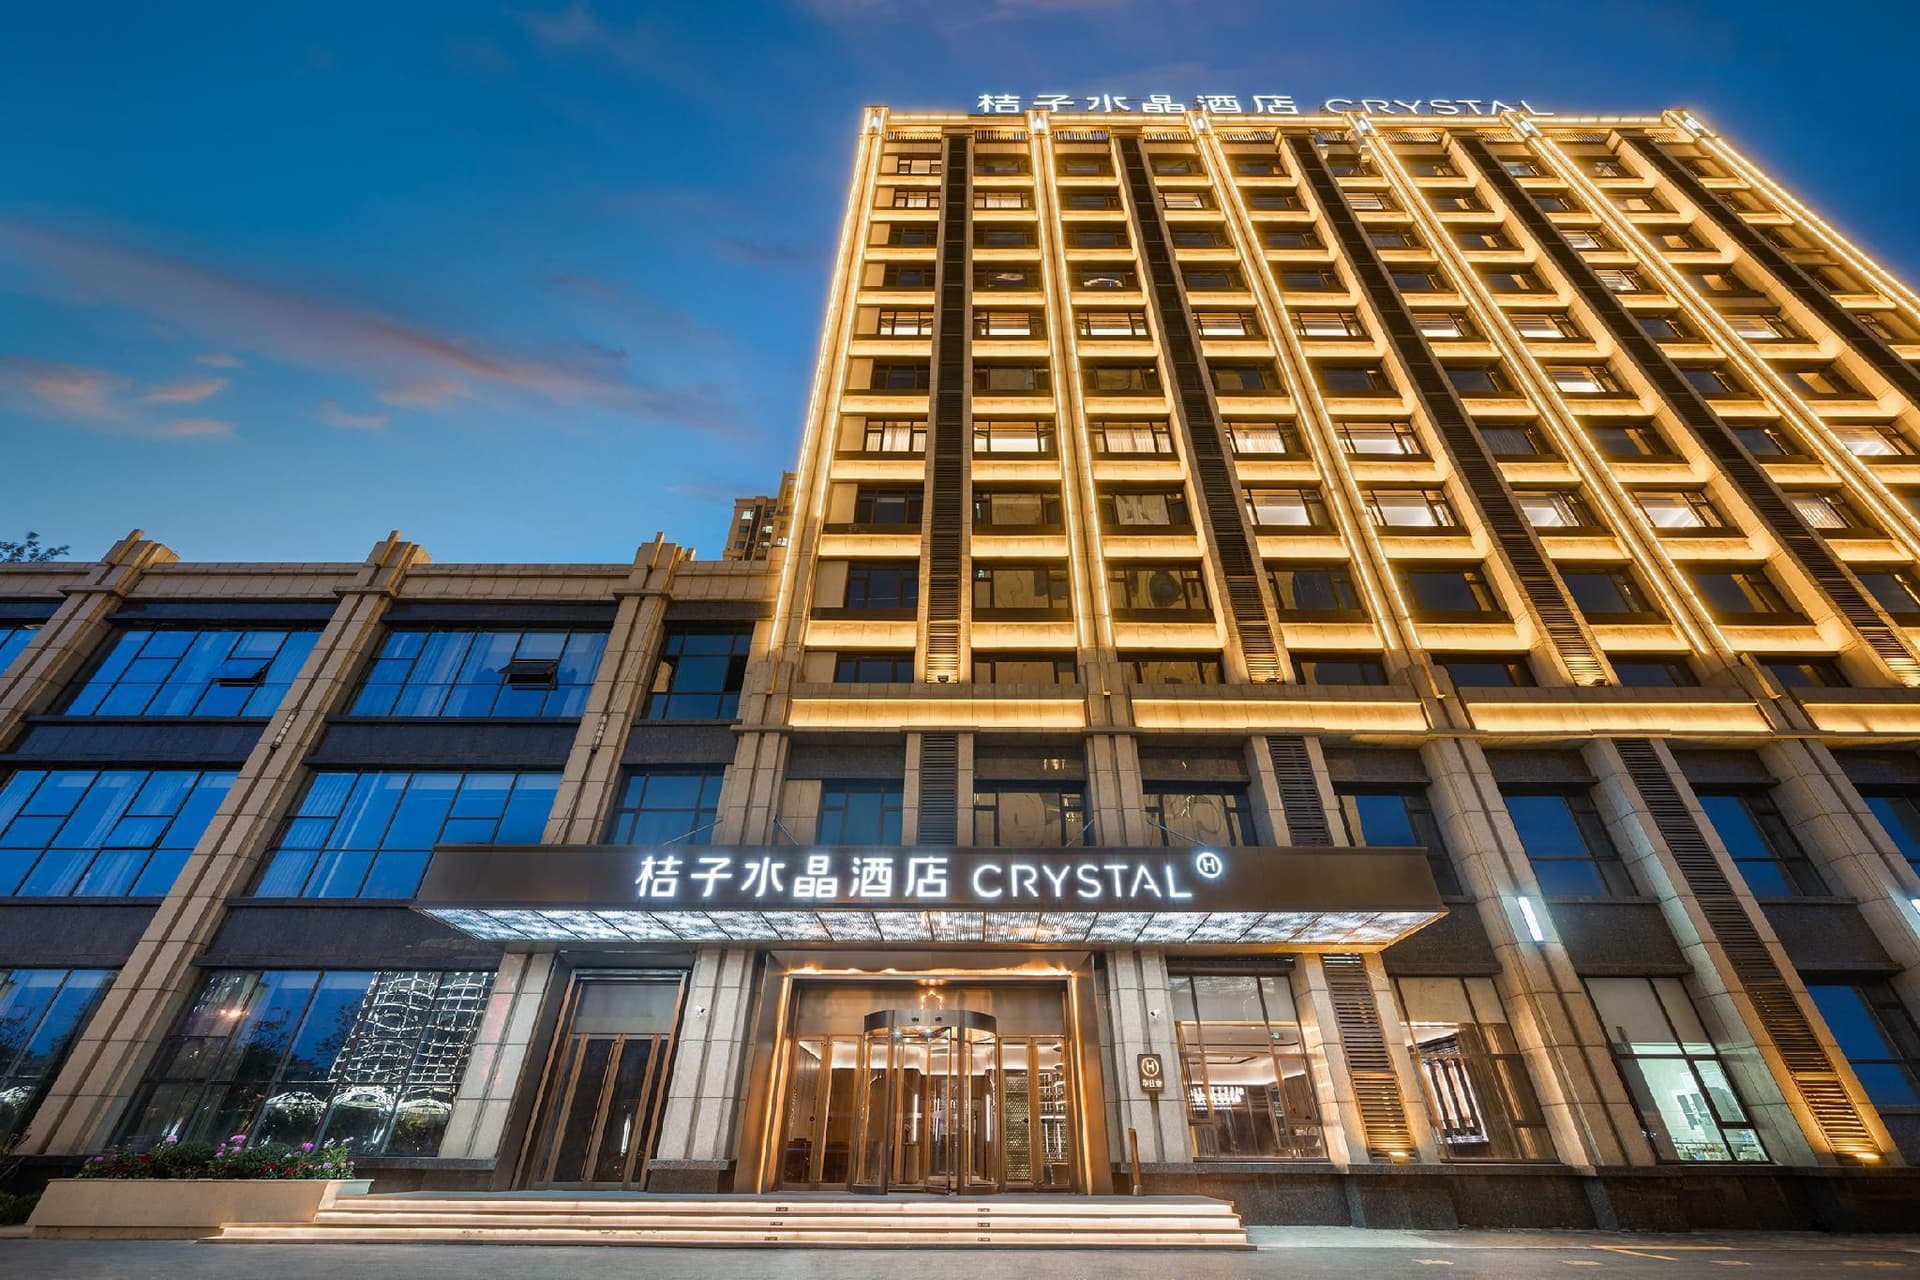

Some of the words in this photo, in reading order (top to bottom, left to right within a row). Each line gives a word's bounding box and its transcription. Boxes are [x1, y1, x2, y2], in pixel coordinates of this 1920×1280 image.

[977, 94, 1299, 114] 桔子水晶酒店
[1325, 99, 1554, 115] CRYSTAL
[635, 855, 948, 897] 桔子水晶酒店
[973, 864, 1193, 898] CRYSTAL
